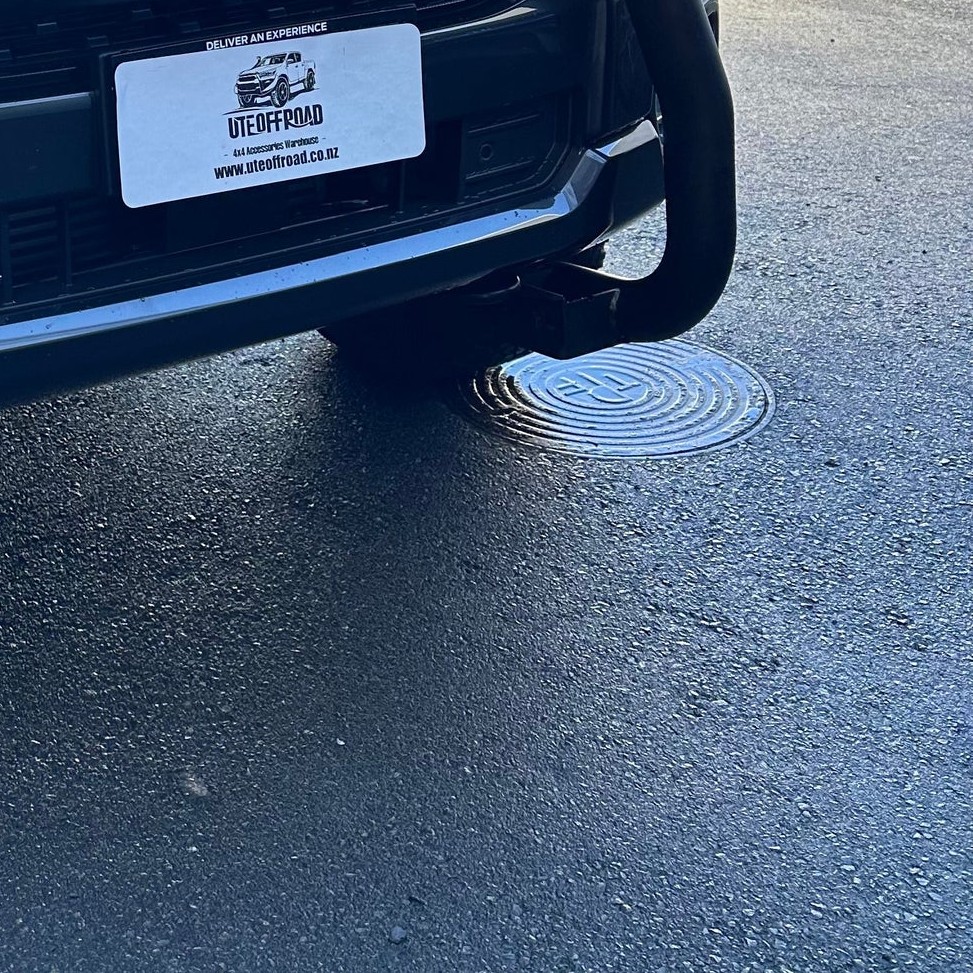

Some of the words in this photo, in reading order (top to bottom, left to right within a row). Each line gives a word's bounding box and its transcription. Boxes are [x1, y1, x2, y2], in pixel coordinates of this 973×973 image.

[206, 35, 248, 51] DELIVER
[250, 32, 265, 43] AN
[266, 21, 328, 40] EXPERIENCE
[227, 104, 324, 139] UTEOFFROAD
[213, 146, 340, 180] www.uteoffroad.co.nz
[233, 146, 246, 158] 4x4
[246, 141, 284, 156] Accessories
[284, 136, 319, 149] Warehouse
